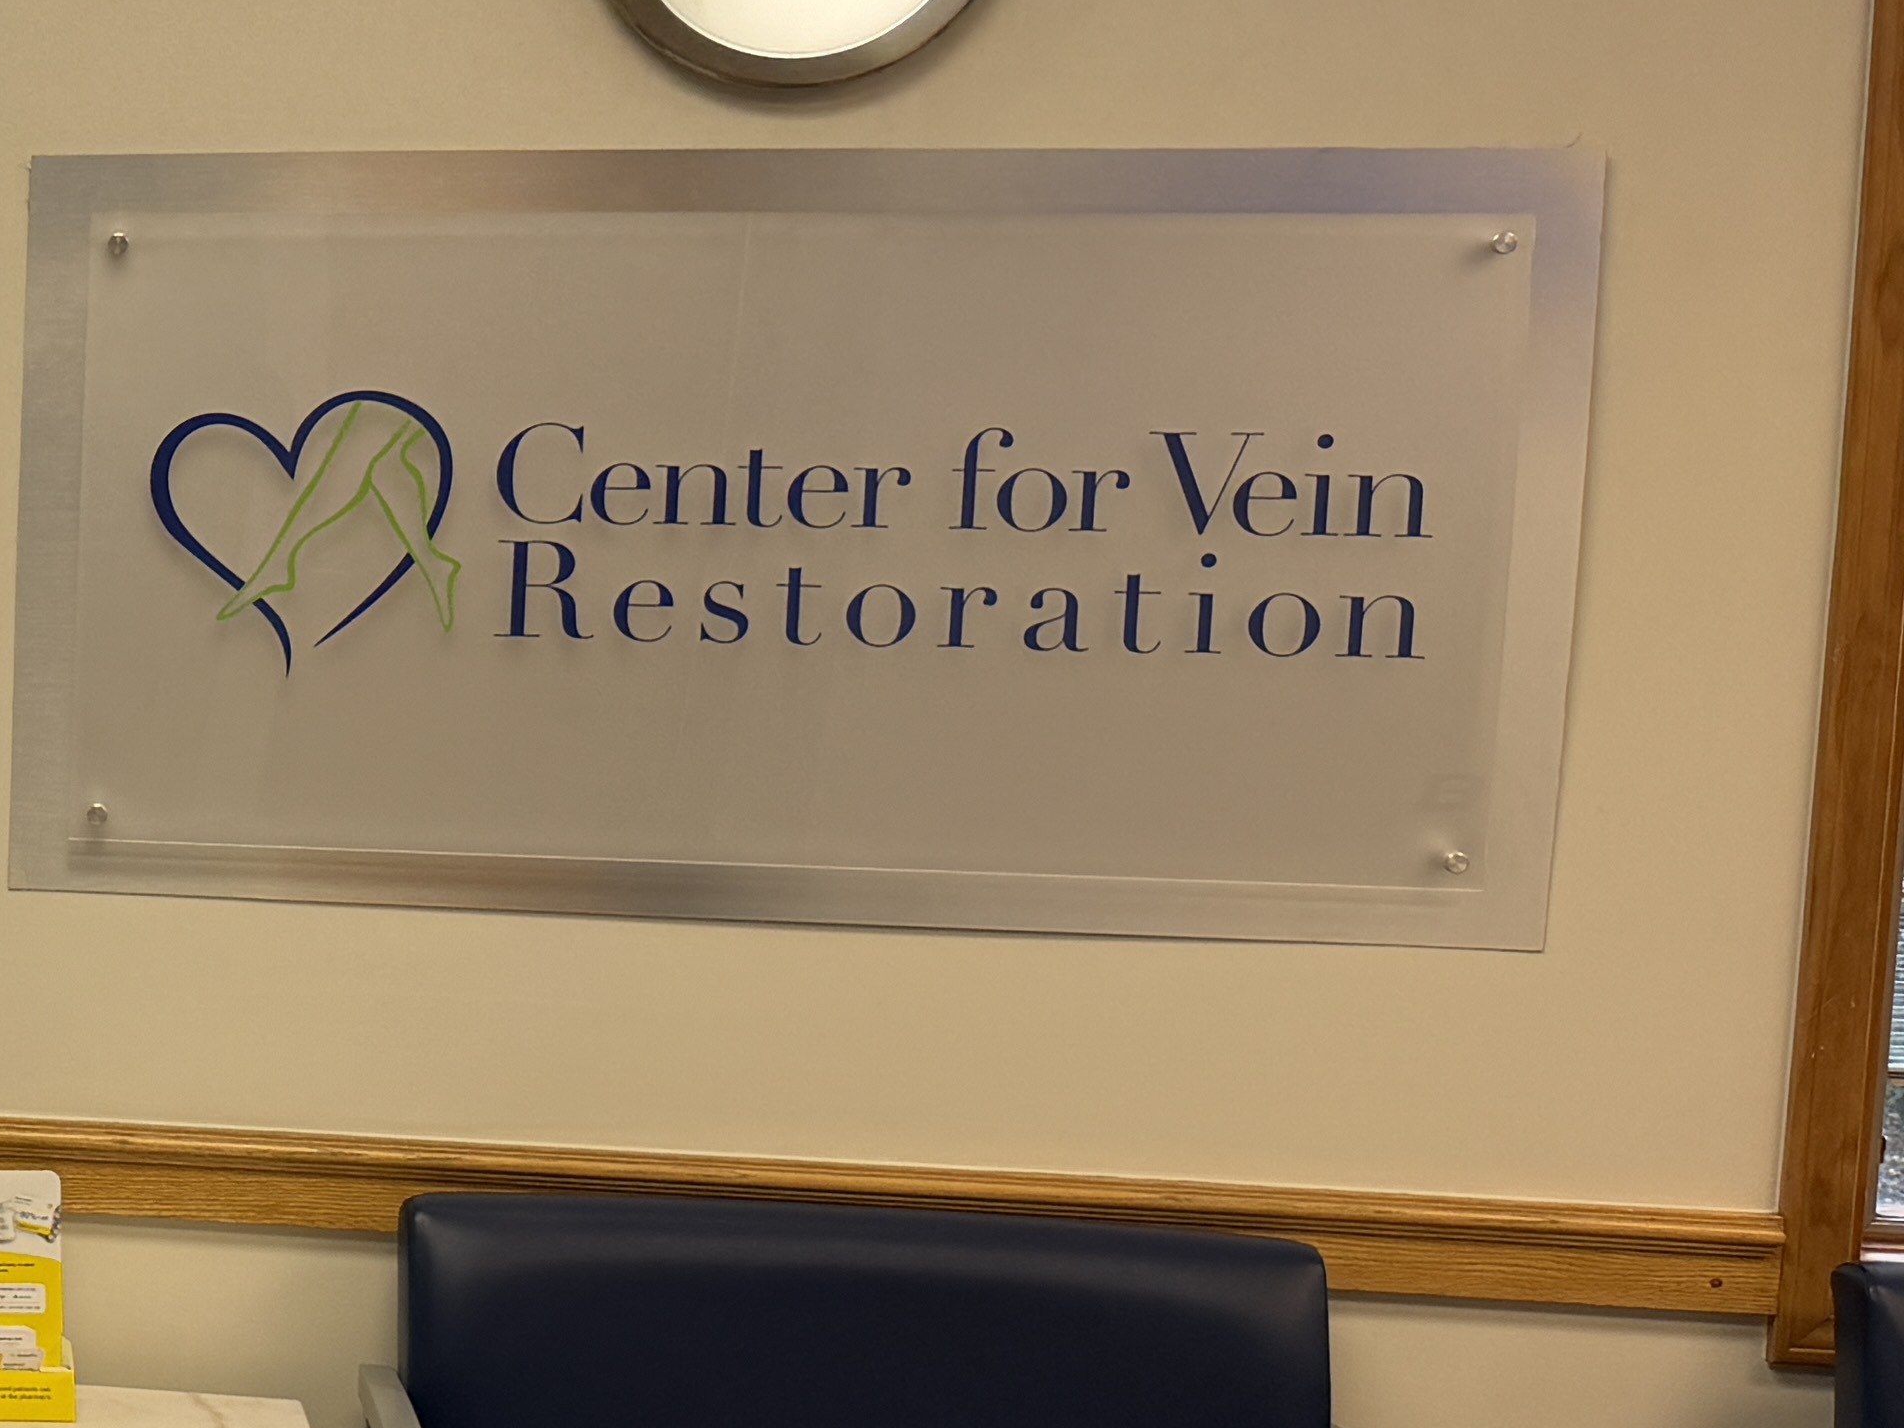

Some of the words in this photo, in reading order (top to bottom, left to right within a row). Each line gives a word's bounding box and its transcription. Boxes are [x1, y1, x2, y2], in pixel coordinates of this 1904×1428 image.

[495, 421, 913, 530] Center
[957, 427, 1131, 533] for
[1150, 430, 1433, 539] Vein
[494, 538, 1427, 661] Restoration
